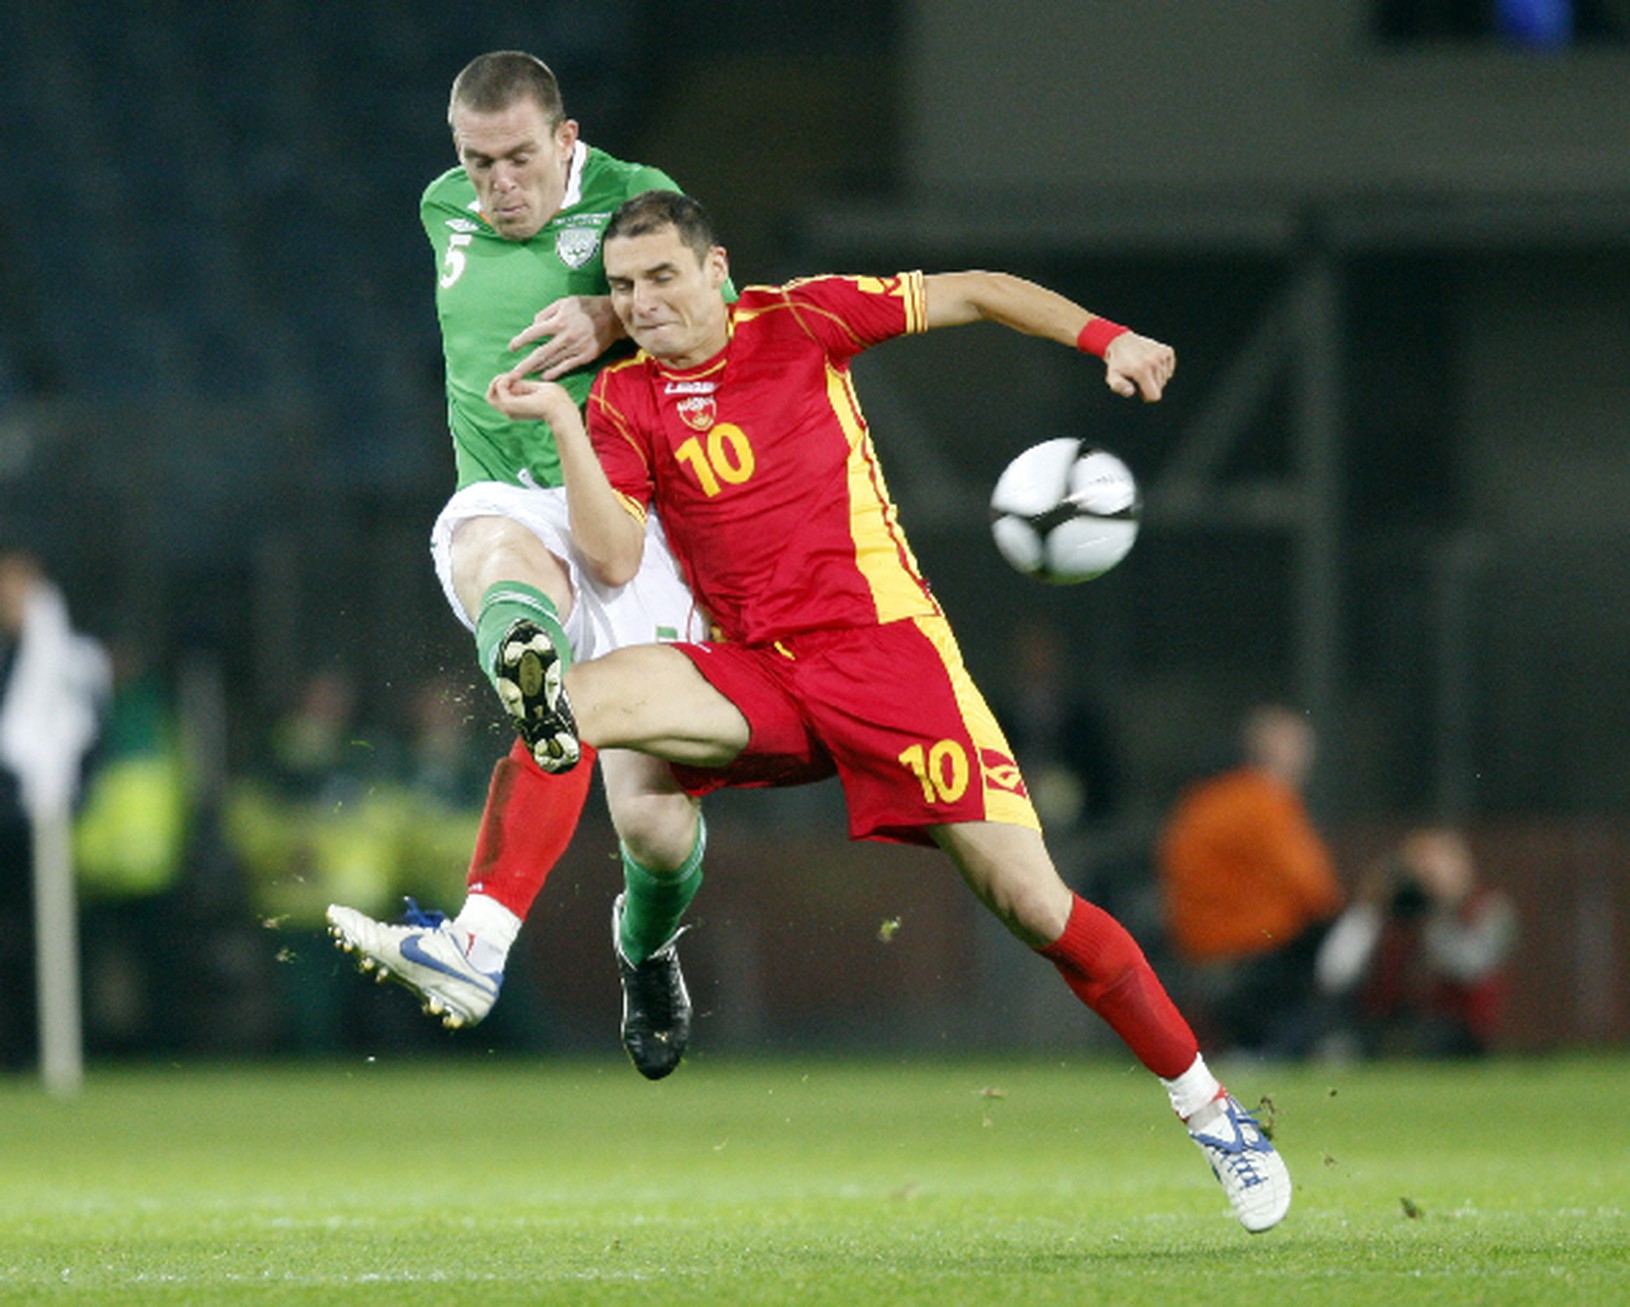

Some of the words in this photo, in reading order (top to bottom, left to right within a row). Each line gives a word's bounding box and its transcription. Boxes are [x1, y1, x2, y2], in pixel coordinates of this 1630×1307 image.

[439, 233, 473, 289] 5
[674, 422, 755, 498] 10
[898, 739, 969, 804] 10
